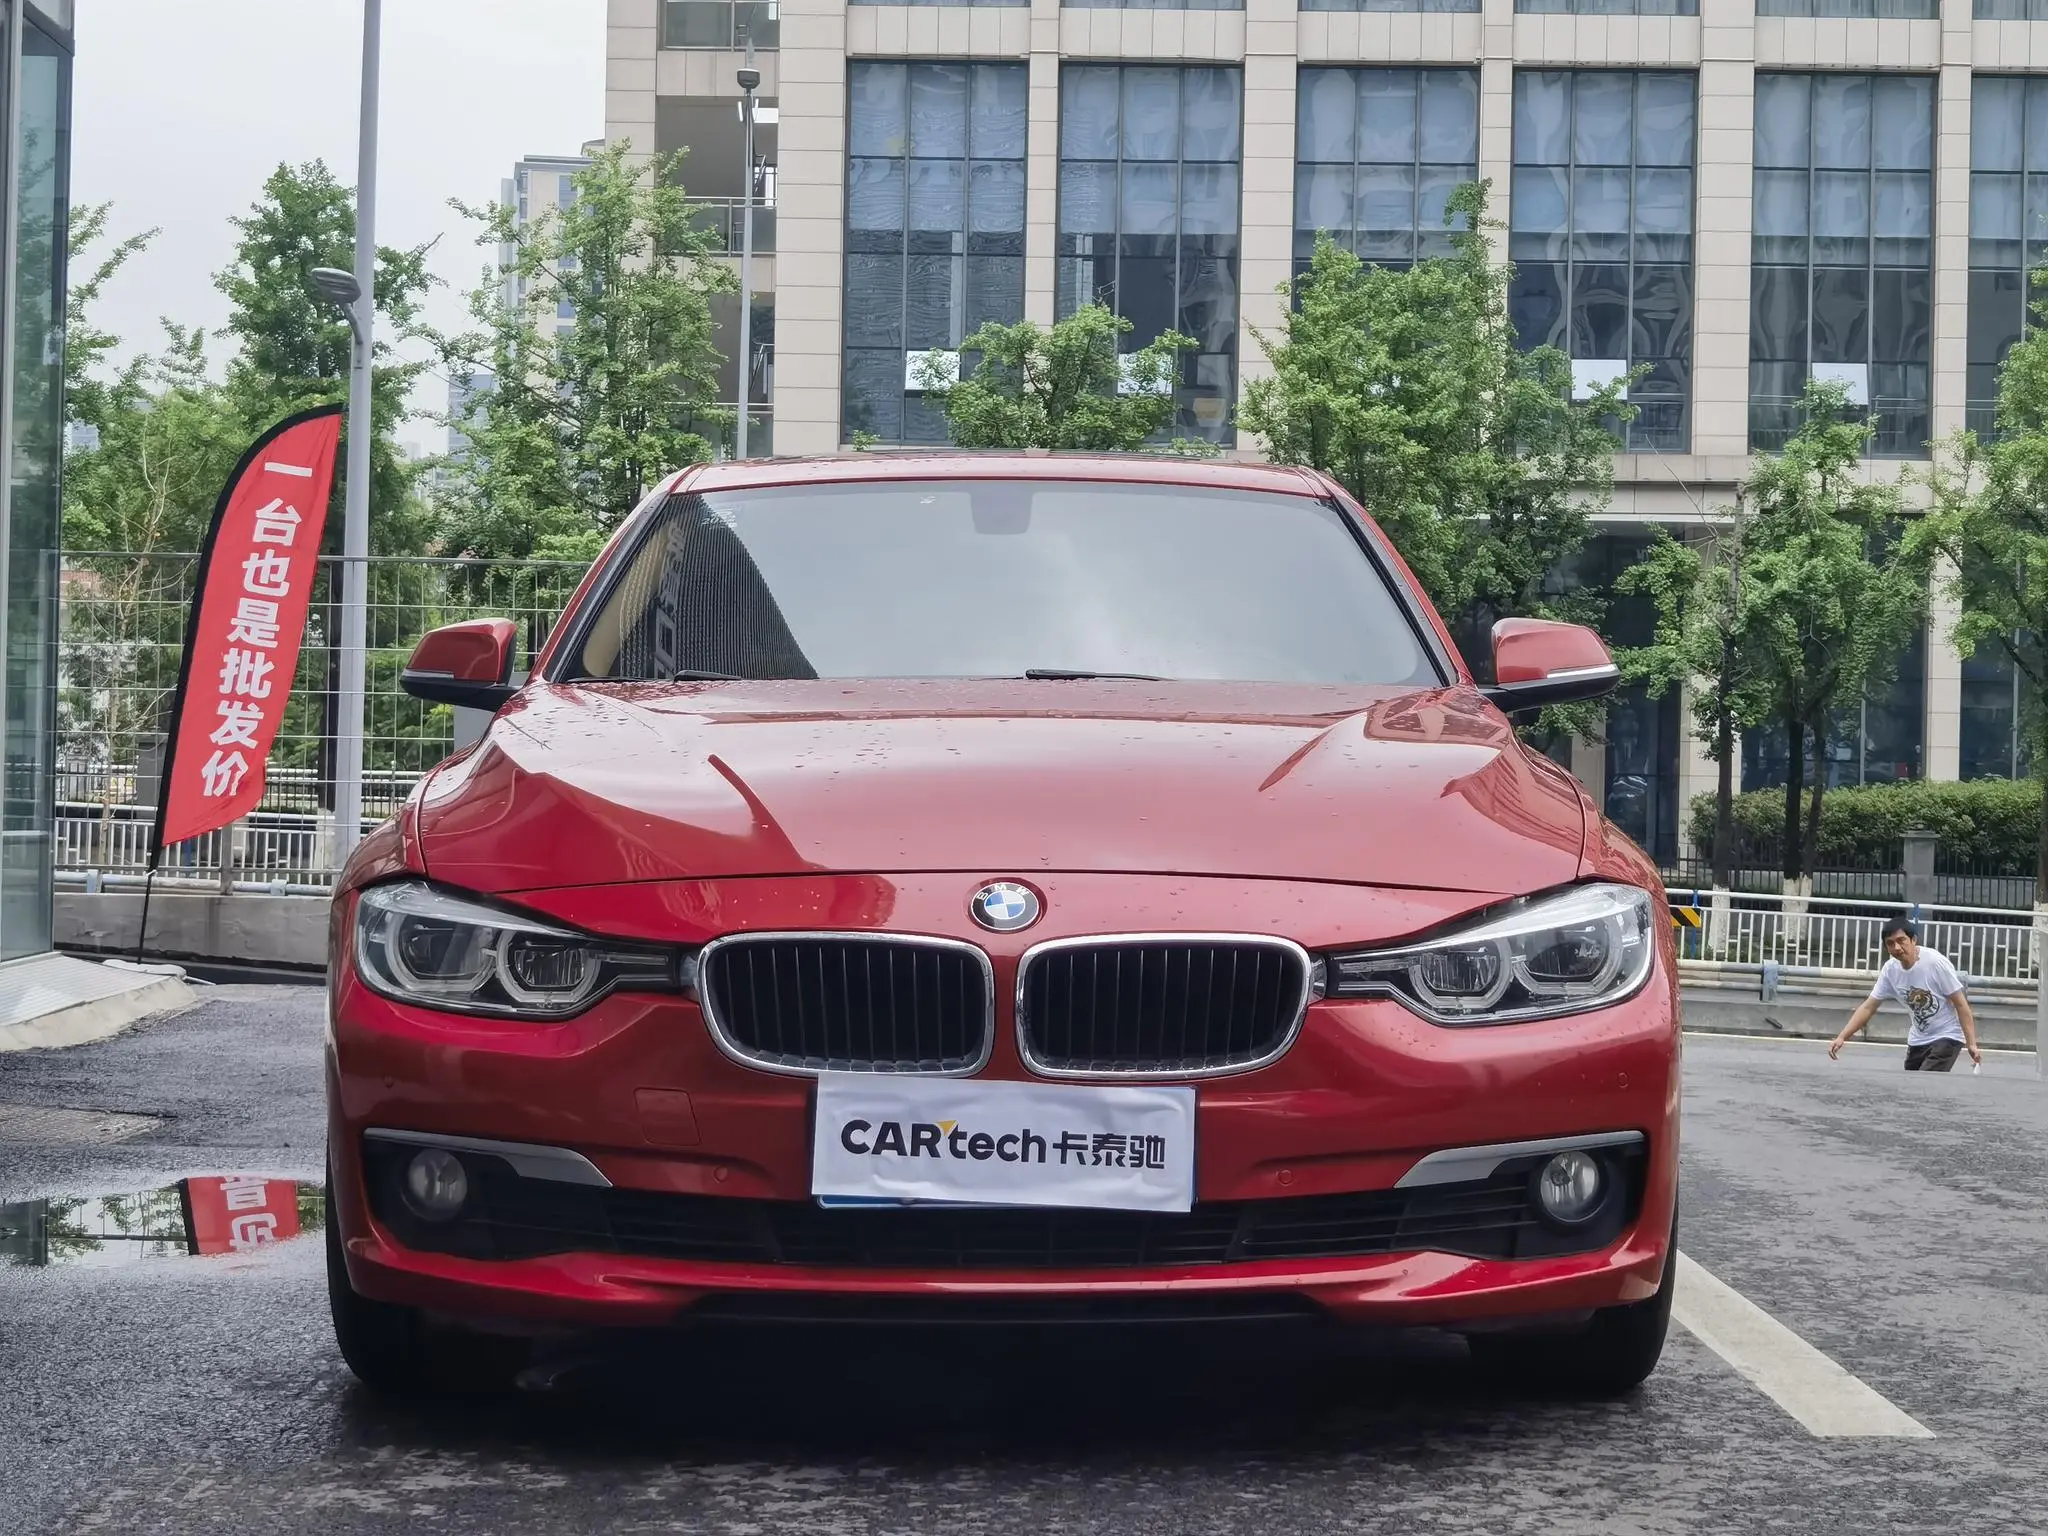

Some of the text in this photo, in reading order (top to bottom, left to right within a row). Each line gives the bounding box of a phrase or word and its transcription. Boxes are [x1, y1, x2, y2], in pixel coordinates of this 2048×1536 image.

[201, 461, 313, 797] 一台也是批发价
[975, 884, 1030, 901] BMW
[841, 1119, 1166, 1170] CARtech 卡泰驰
